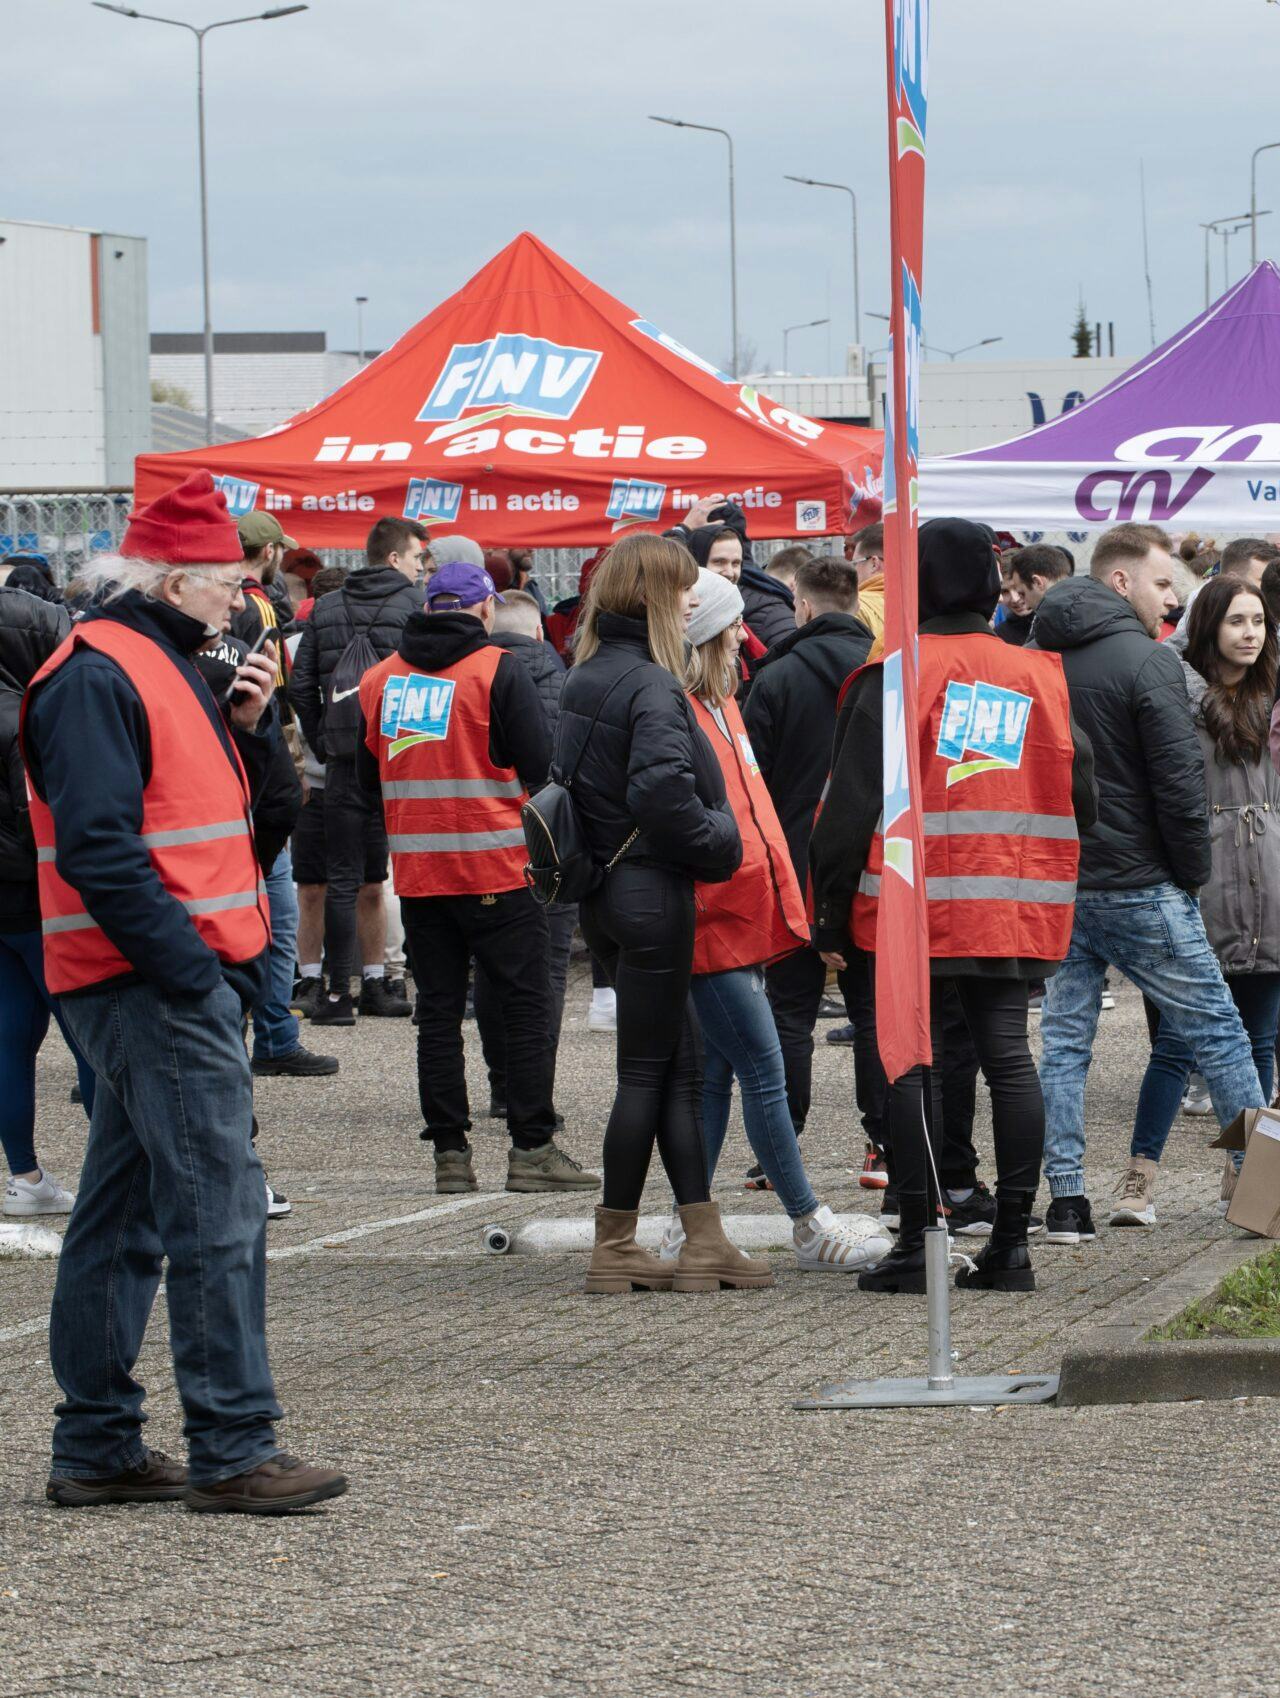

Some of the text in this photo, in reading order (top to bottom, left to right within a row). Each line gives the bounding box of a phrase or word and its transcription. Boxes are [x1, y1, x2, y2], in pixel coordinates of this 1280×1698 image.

[432, 351, 593, 408] FNV
[314, 436, 412, 462] in
[443, 426, 707, 460] actie
[214, 485, 375, 511] NV in actie
[407, 486, 580, 511] FNV in actie
[610, 487, 663, 510] FNV
[383, 685, 451, 723] FNV
[944, 700, 1028, 745] FNV
